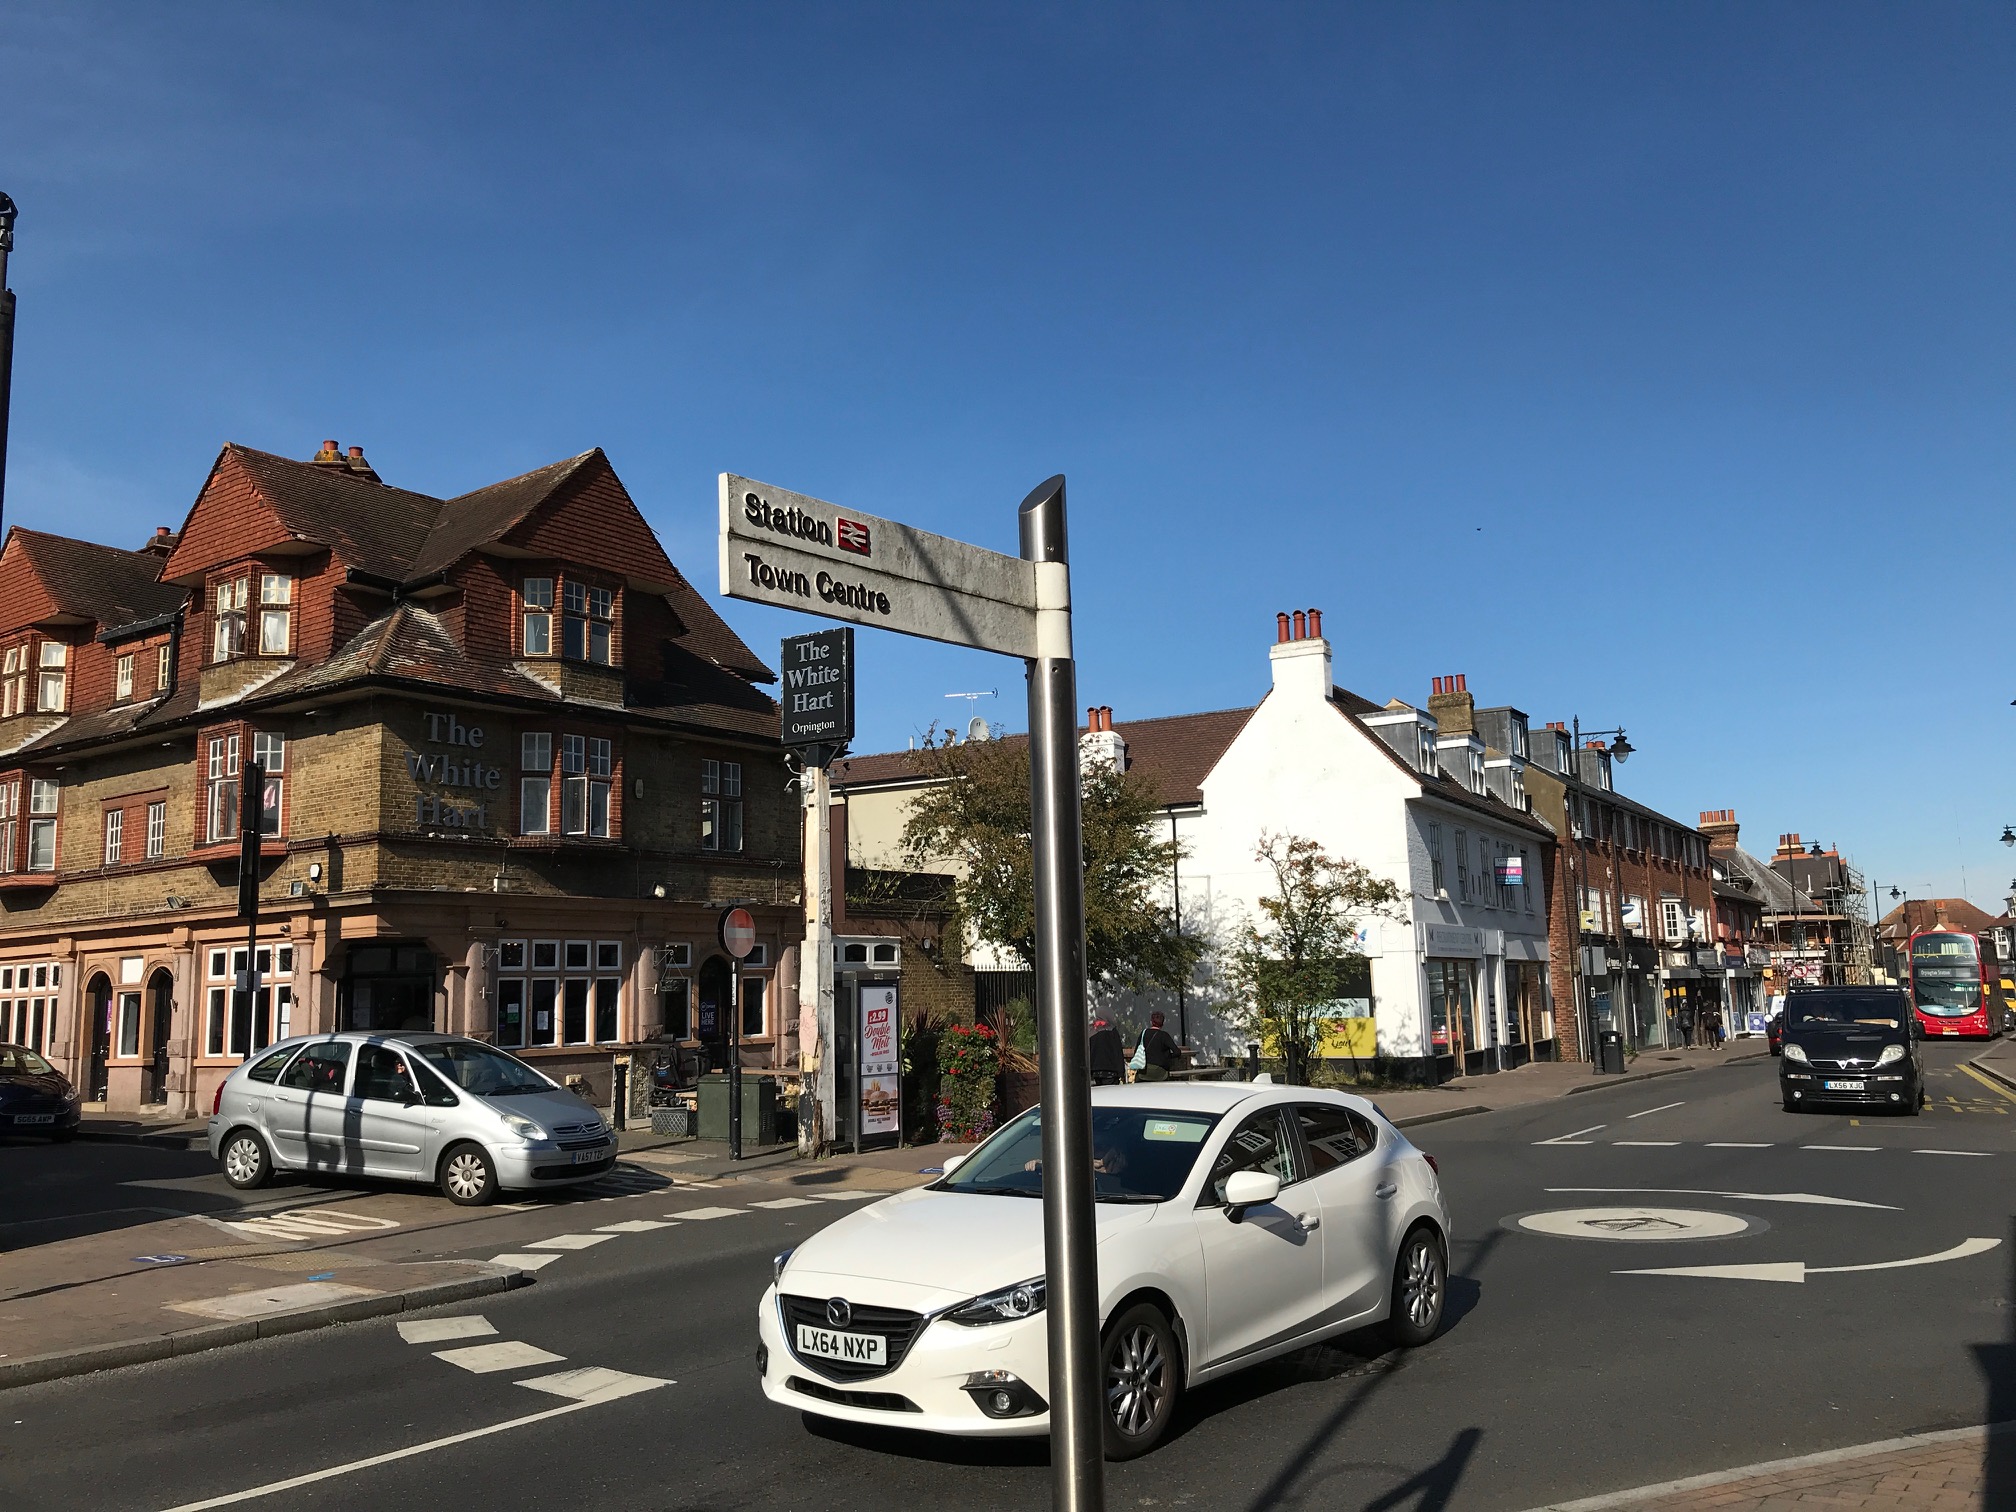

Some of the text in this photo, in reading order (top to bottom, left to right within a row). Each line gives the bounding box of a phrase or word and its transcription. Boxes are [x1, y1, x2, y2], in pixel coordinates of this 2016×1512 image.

[743, 491, 832, 548] Station
[742, 551, 891, 615] Town Centre
[796, 641, 830, 662] The
[787, 665, 840, 688] White
[793, 691, 834, 713] Hart
[423, 711, 484, 748] The
[792, 721, 835, 735] Orpington
[404, 751, 500, 790] White
[415, 795, 488, 830] Hart
[864, 1023, 891, 1039] Double
[577, 1151, 593, 1162] VA57
[802, 1328, 878, 1360] LX64 NXP
